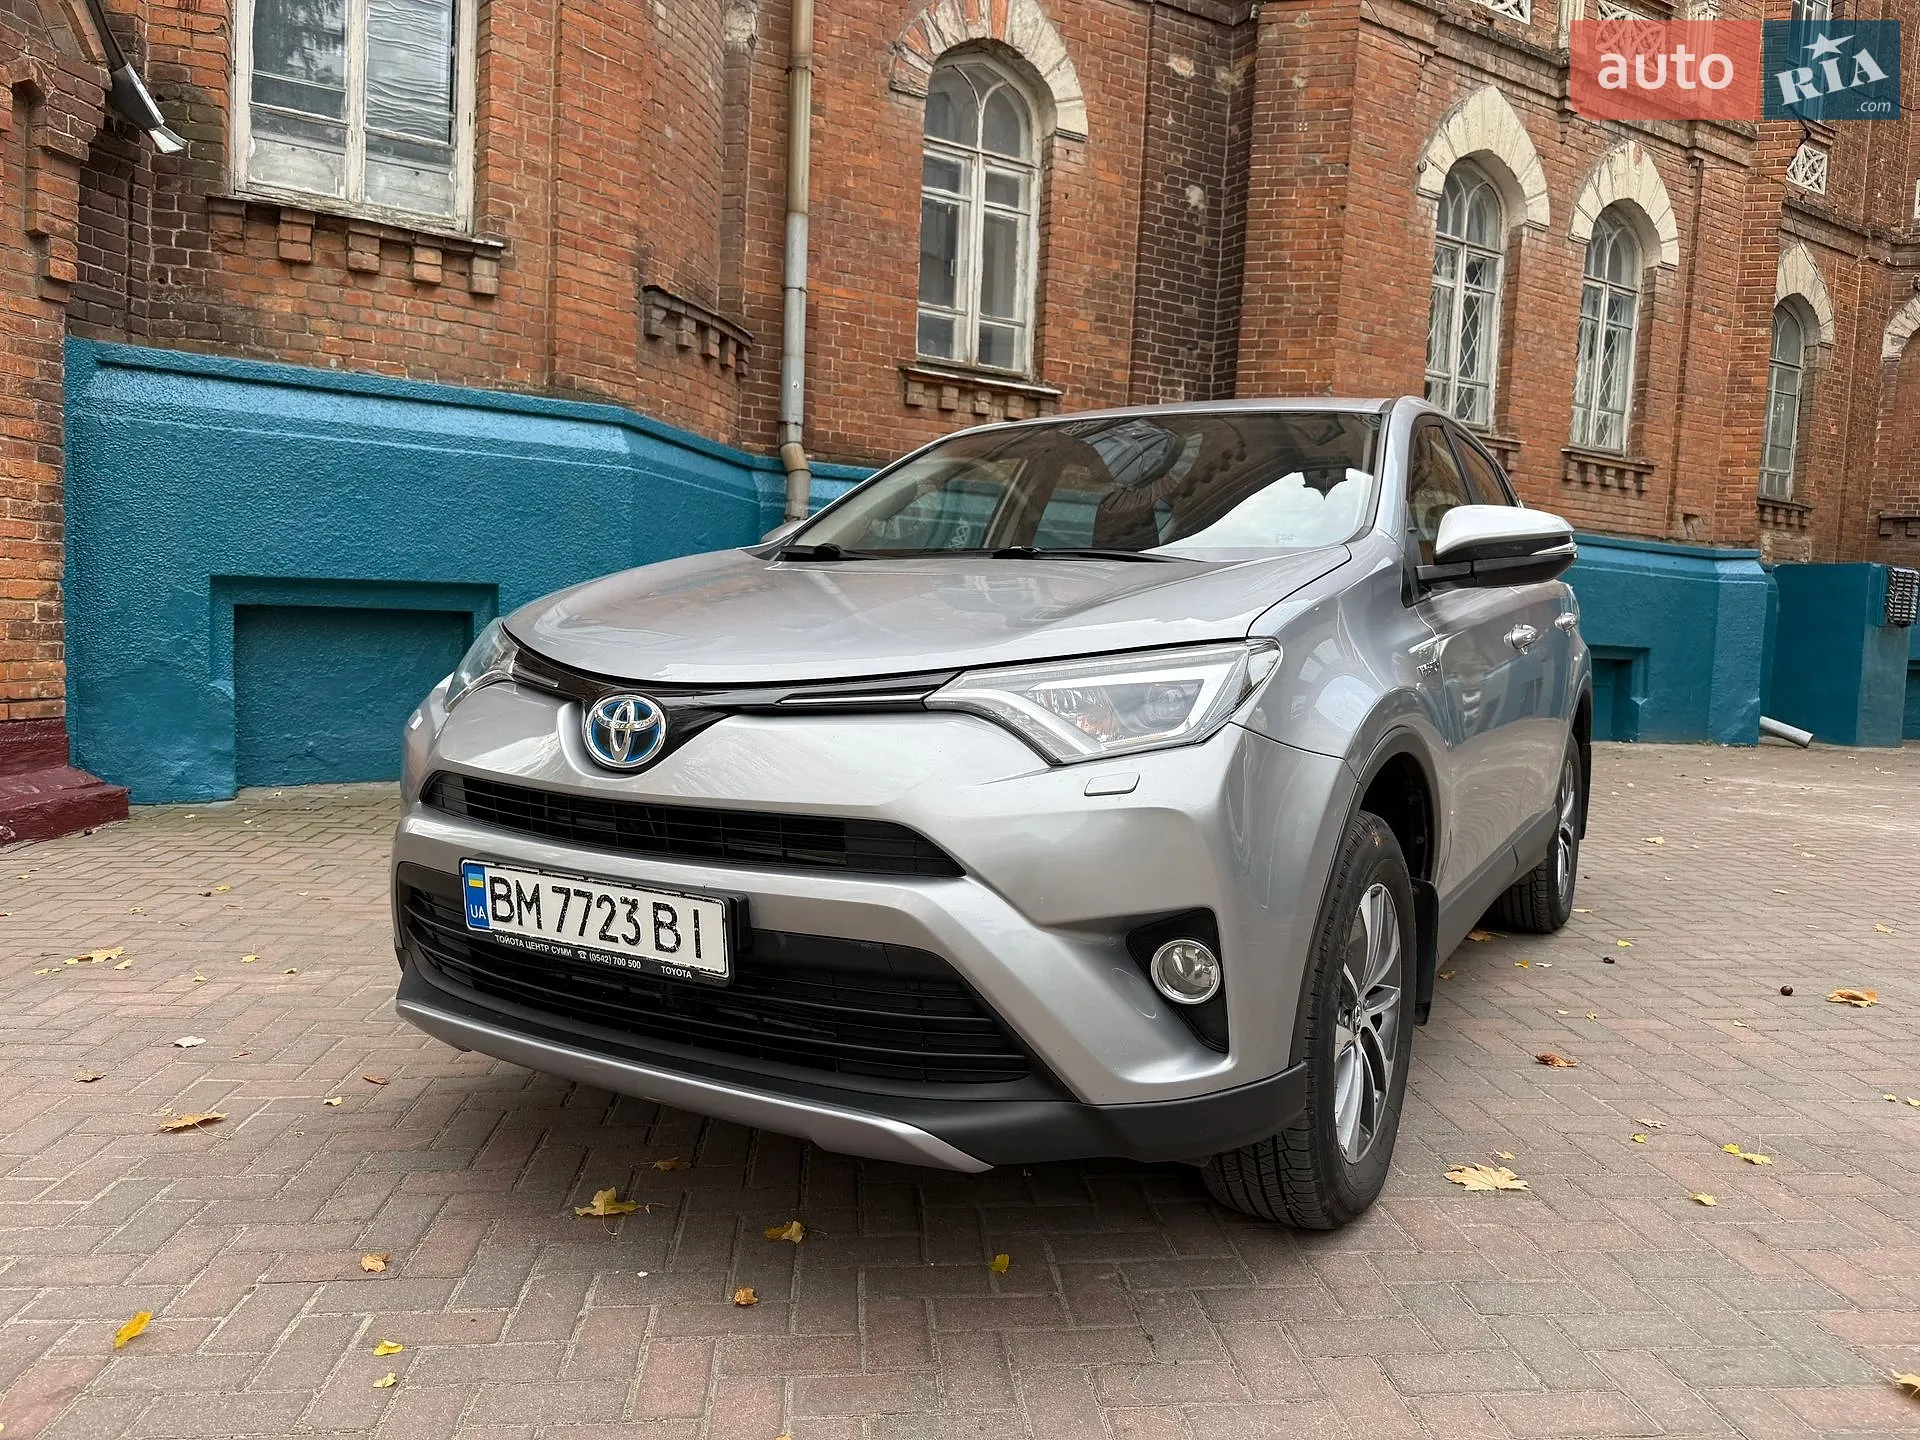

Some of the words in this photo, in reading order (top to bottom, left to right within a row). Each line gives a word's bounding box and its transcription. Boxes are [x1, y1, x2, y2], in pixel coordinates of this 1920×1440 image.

[470, 904, 487, 920] UA
[489, 875, 543, 930] BM
[551, 885, 641, 946] 7723
[494, 934, 525, 948] ТОЙОТА
[525, 941, 550, 952] ЦЕНТР
[551, 946, 573, 957] СУМИ
[589, 951, 612, 966] (0542)
[612, 956, 627, 967] 700
[627, 959, 642, 969] 500
[660, 965, 693, 979] TOYOTA
